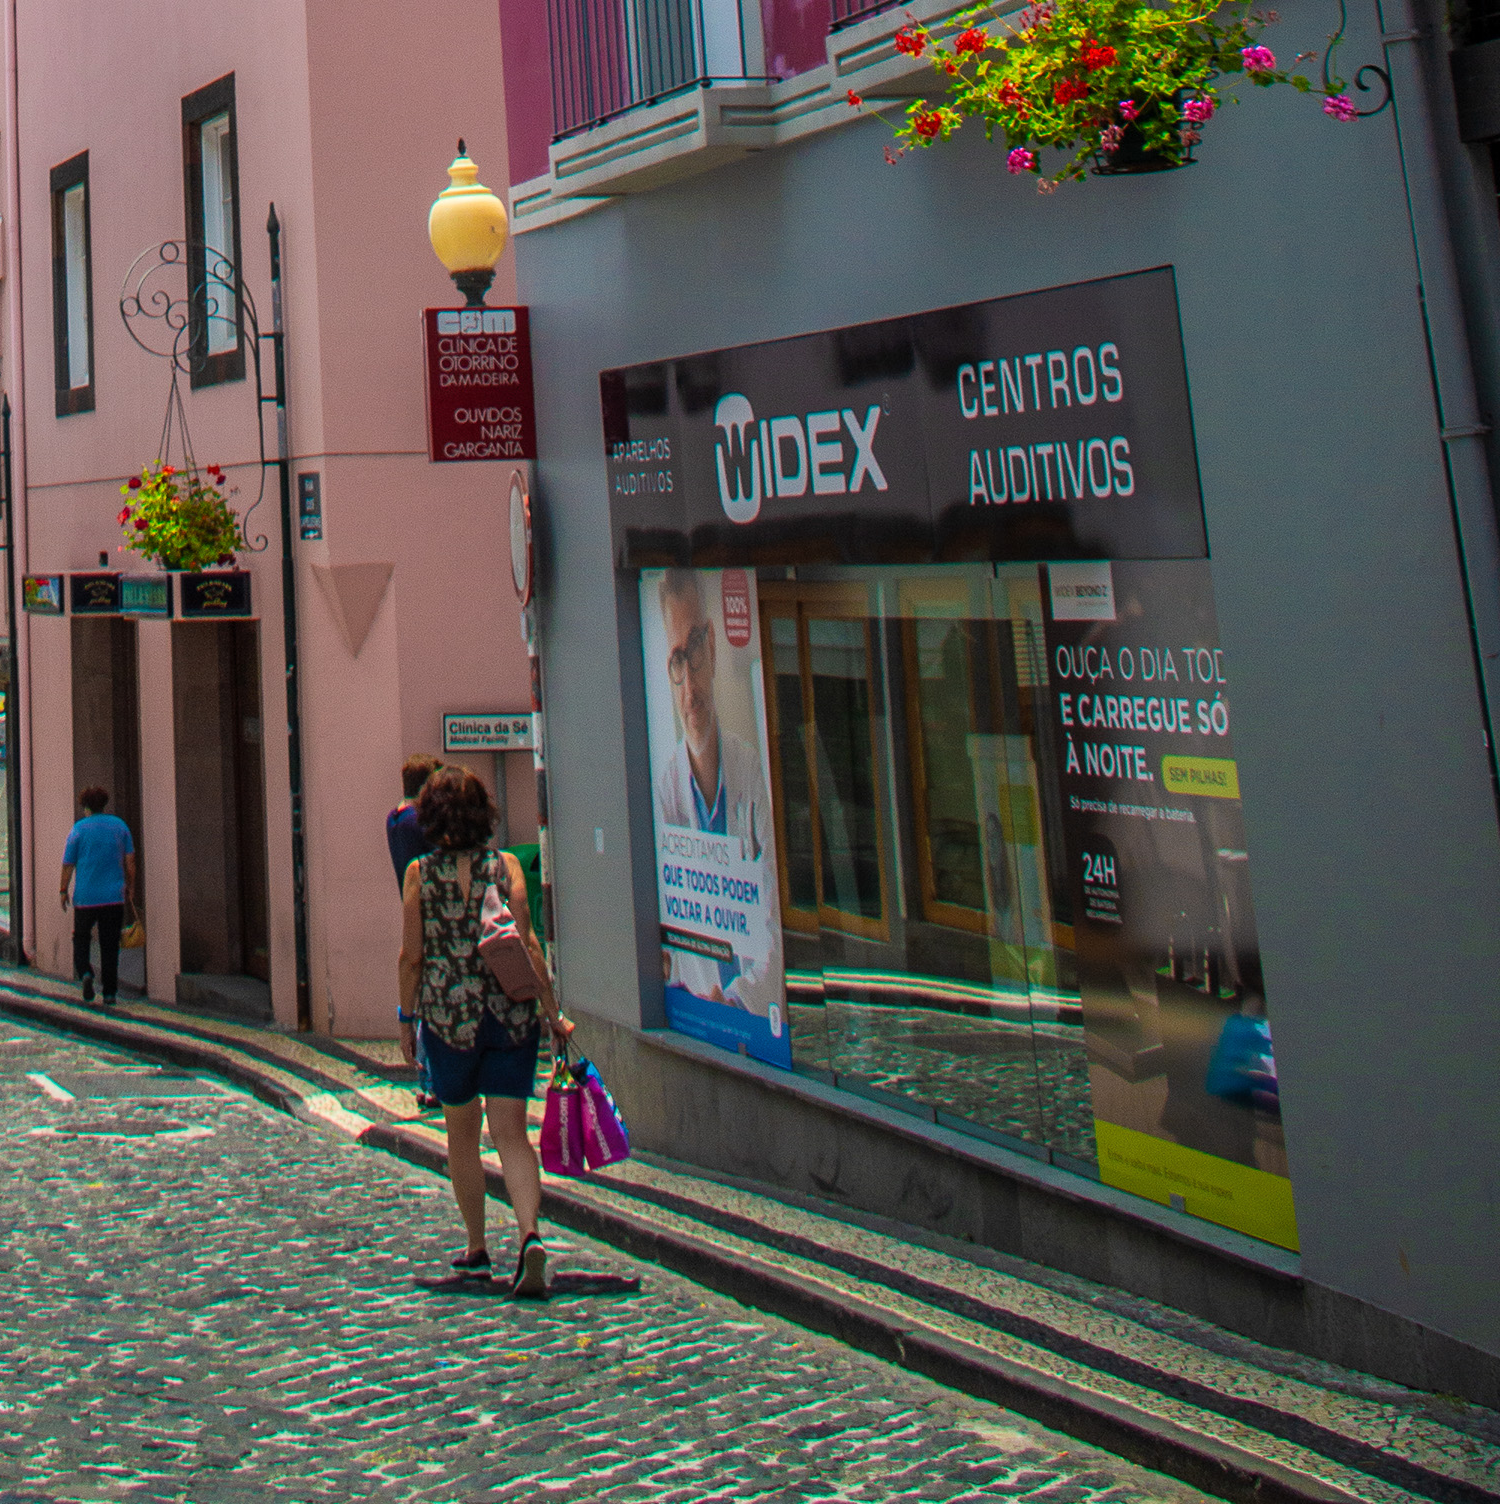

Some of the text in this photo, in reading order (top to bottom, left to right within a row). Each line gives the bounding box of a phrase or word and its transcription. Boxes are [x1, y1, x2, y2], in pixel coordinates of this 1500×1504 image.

[438, 336, 518, 354] CLÍNICA DE
[439, 354, 519, 372] OTORRINO
[457, 373, 520, 387] MADEIRA
[957, 341, 1123, 419] CENTROS
[454, 407, 523, 423] OUVIDOS
[481, 424, 523, 439] NARIZ
[443, 442, 524, 457] GARGANTA
[612, 437, 672, 463] APARELHOS
[714, 392, 889, 525] WIDEX
[615, 470, 674, 495] AUDITIVOS
[968, 435, 1135, 506] AUDITIVOS
[1055, 645, 1115, 685] OUÇA
[1117, 645, 1135, 681] O
[1139, 646, 1180, 682] DIA
[494, 721, 510, 734] da
[512, 720, 528, 734] Sé
[1058, 690, 1230, 736] E CARREGUE SÓ
[1066, 732, 1155, 782] À NOITE.
[661, 831, 730, 866] ACREDITAMOS
[663, 863, 760, 906] QUE TODOS PODEM
[1081, 851, 1118, 887] 24H
[664, 894, 750, 936] VOLTAR A OUVIR.
